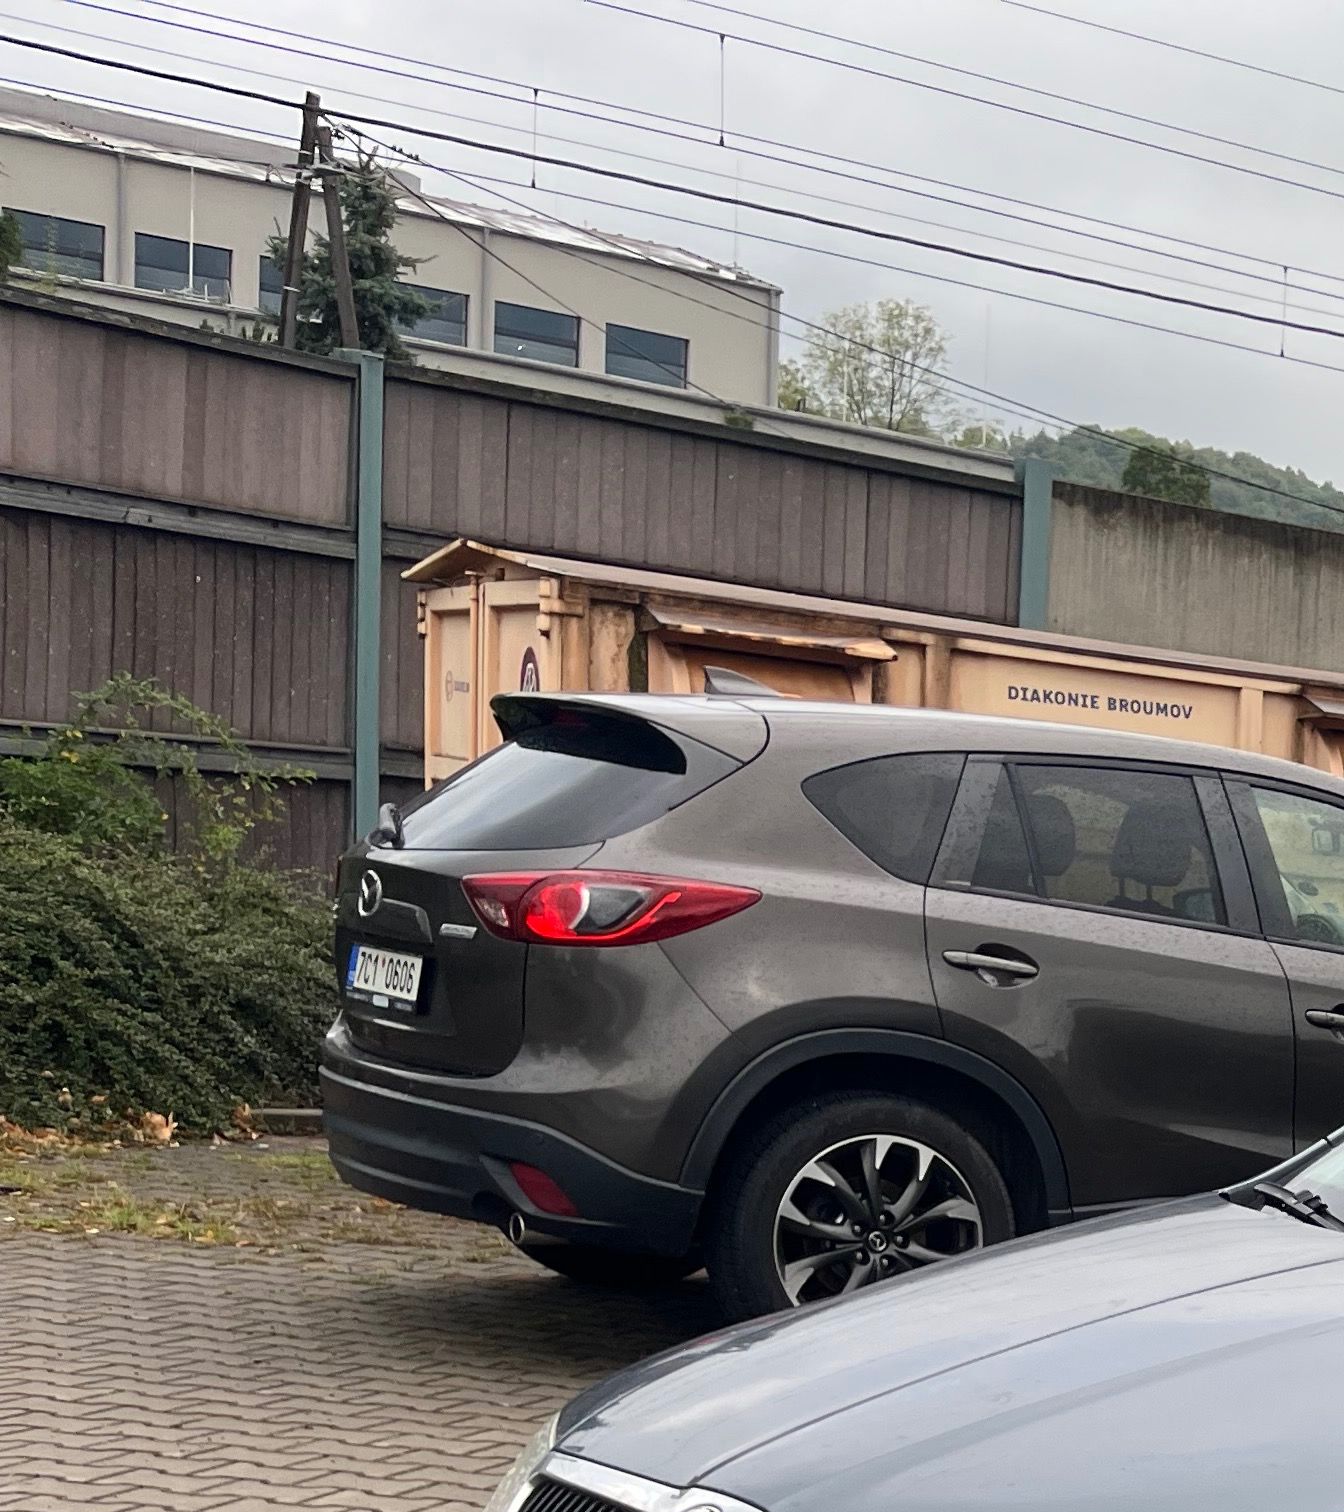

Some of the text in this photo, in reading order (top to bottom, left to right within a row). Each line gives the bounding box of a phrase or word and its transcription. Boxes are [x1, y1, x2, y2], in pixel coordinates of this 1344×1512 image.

[1007, 685, 1193, 719] DIAKONIE BROUMOV
[356, 951, 416, 994] 7C1 0606
